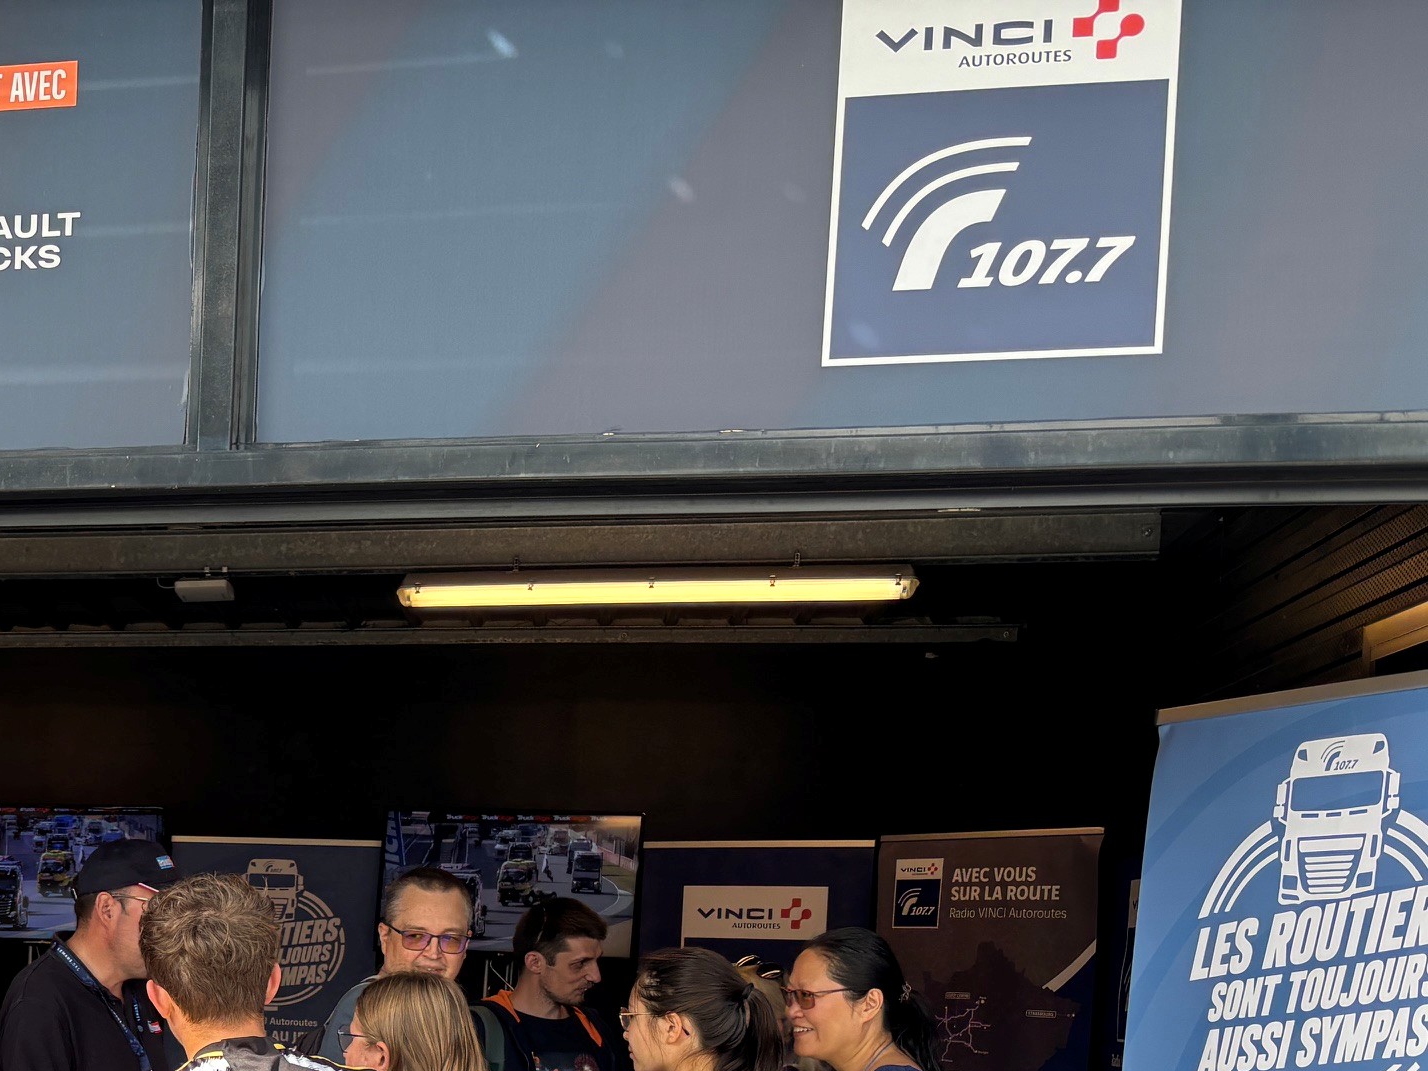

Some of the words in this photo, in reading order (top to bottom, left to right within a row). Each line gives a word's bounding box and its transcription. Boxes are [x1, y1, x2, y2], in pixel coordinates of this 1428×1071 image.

[875, 18, 1053, 53] VINCI
[958, 49, 1072, 68] AUTOROUTES
[10, 69, 67, 102] AVEC
[956, 235, 1136, 289] 107.7
[1333, 759, 1359, 771] 107.7
[952, 867, 990, 882] AVEC
[993, 866, 1036, 882] VOUS
[950, 886, 982, 902] SUR
[984, 886, 1003, 901] LA
[1006, 885, 1060, 901] ROUTE
[697, 907, 773, 920] VINCI
[910, 906, 935, 916] 107.7
[949, 907, 975, 920] Radio
[977, 907, 1007, 919] VINCI
[1009, 906, 1067, 919] Autoroutes
[280, 917, 341, 946] TIERS
[732, 922, 780, 930] AUTOROUTES
[1189, 917, 1259, 982] LES
[1262, 885, 1428, 969] ROUTIER
[279, 944, 332, 966] JOURS
[281, 963, 330, 986] MPAS
[1207, 974, 1283, 1022] SONT
[1286, 952, 1428, 1013] TOUJOUR
[269, 1017, 318, 1028] Autoroutes
[1295, 1004, 1428, 1069] SYMPAS
